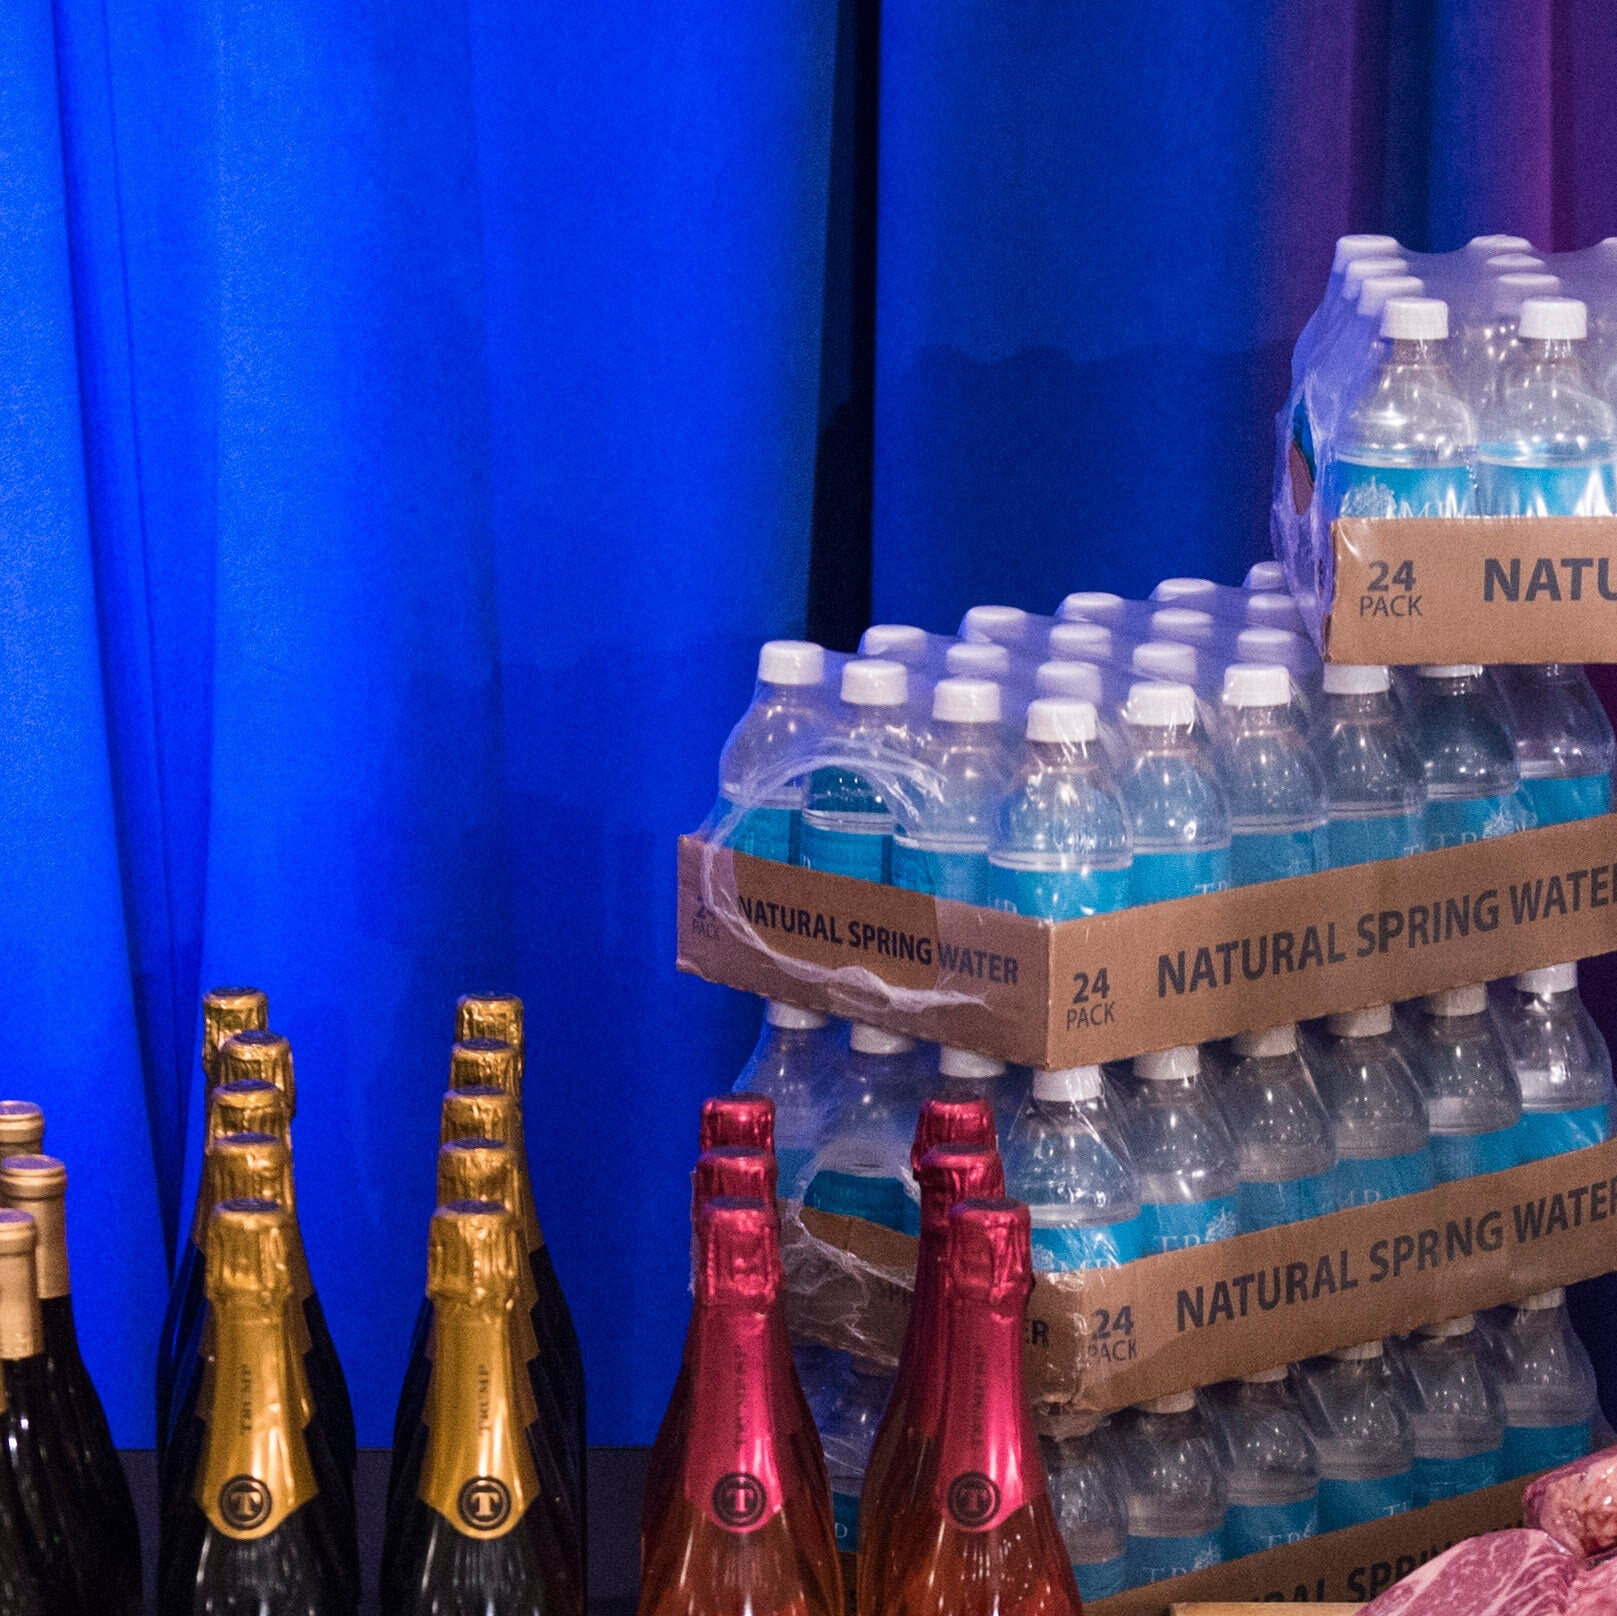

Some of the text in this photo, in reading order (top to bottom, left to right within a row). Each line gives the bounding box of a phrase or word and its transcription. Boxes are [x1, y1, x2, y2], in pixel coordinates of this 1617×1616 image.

[1367, 560, 1416, 592] 24
[1359, 594, 1423, 617] PACK
[736, 896, 1020, 986] NATURAL SPRING WATER
[1157, 922, 1346, 998] NATURAL
[1356, 889, 1500, 960] SPRING
[1073, 968, 1110, 1005] 24
[1066, 1001, 1116, 1031] PACK
[1175, 1247, 1359, 1333] NATURAL
[1091, 1304, 1134, 1340] 24
[470, 1491, 500, 1517] T
